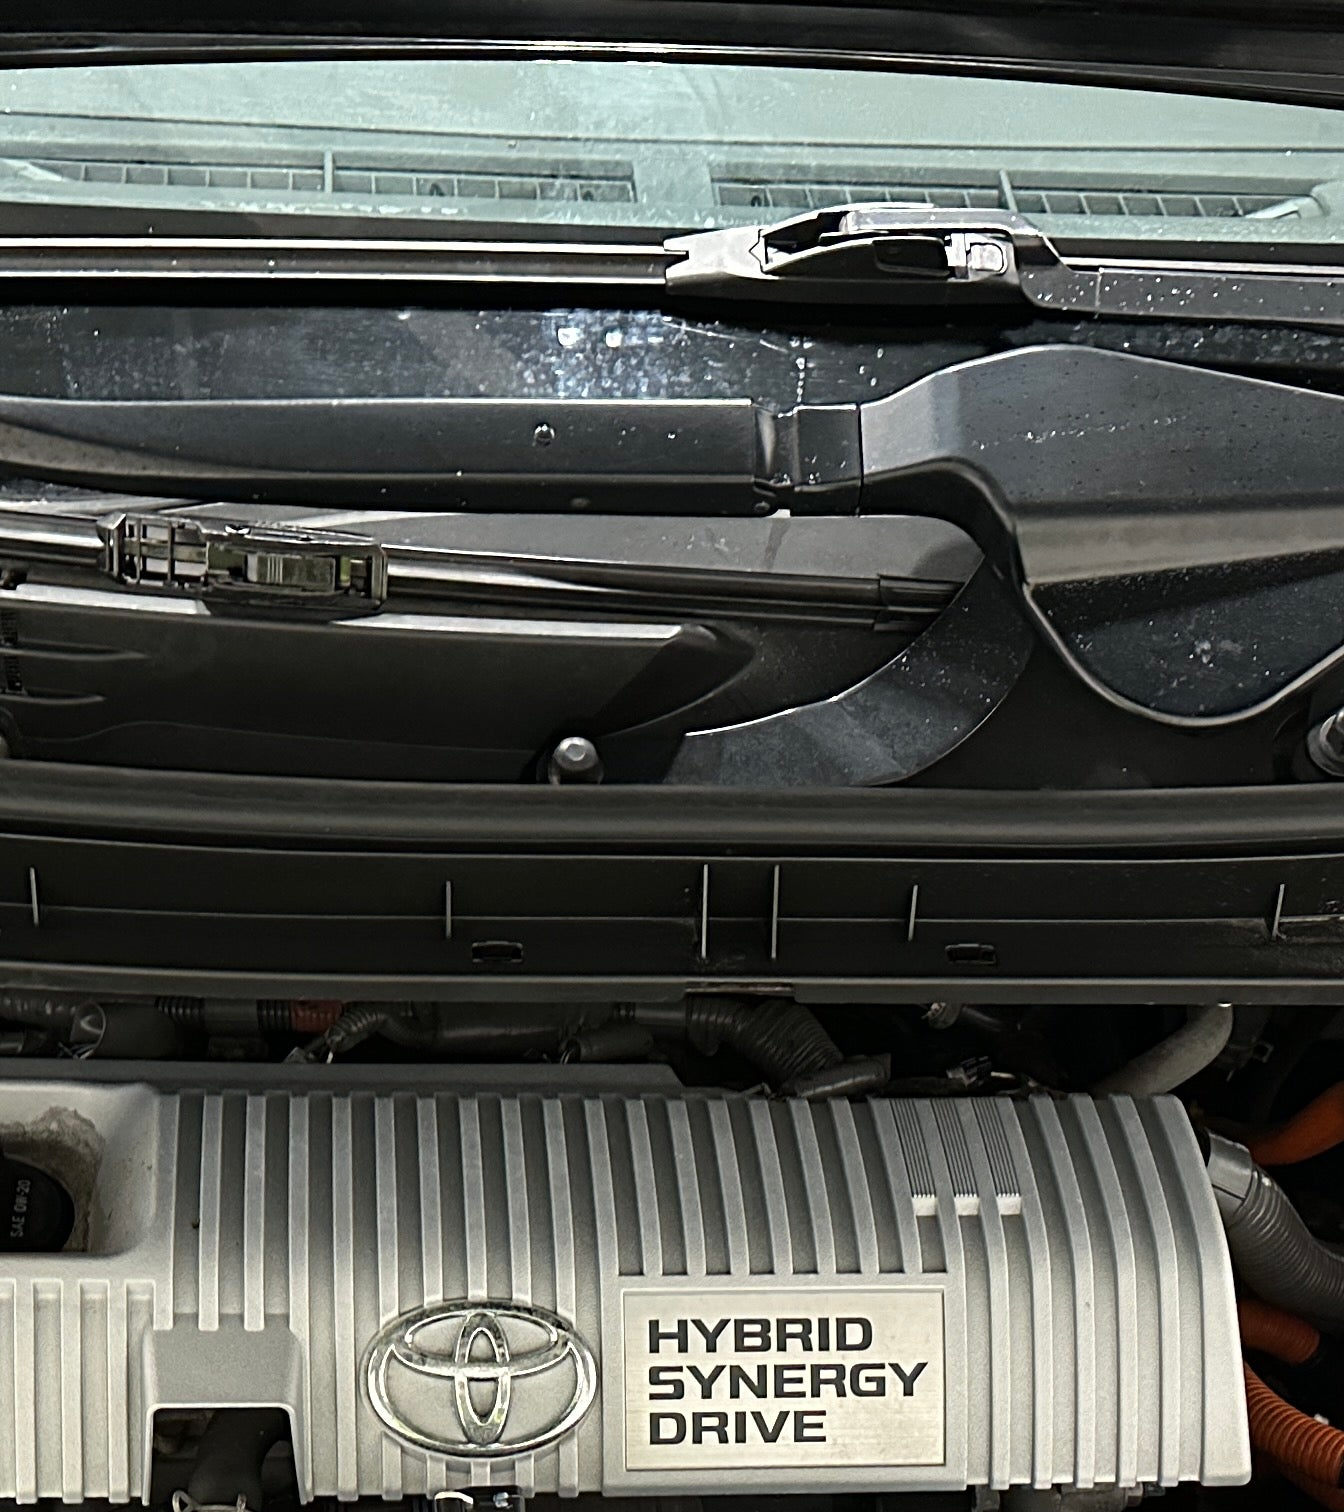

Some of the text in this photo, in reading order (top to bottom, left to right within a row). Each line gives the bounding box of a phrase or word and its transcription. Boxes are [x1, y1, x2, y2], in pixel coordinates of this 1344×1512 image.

[10, 1215, 26, 1238] SAE
[649, 1317, 874, 1354] HYBRID
[649, 1361, 929, 1401] SYNERGY
[649, 1410, 828, 1445] DRIVE
